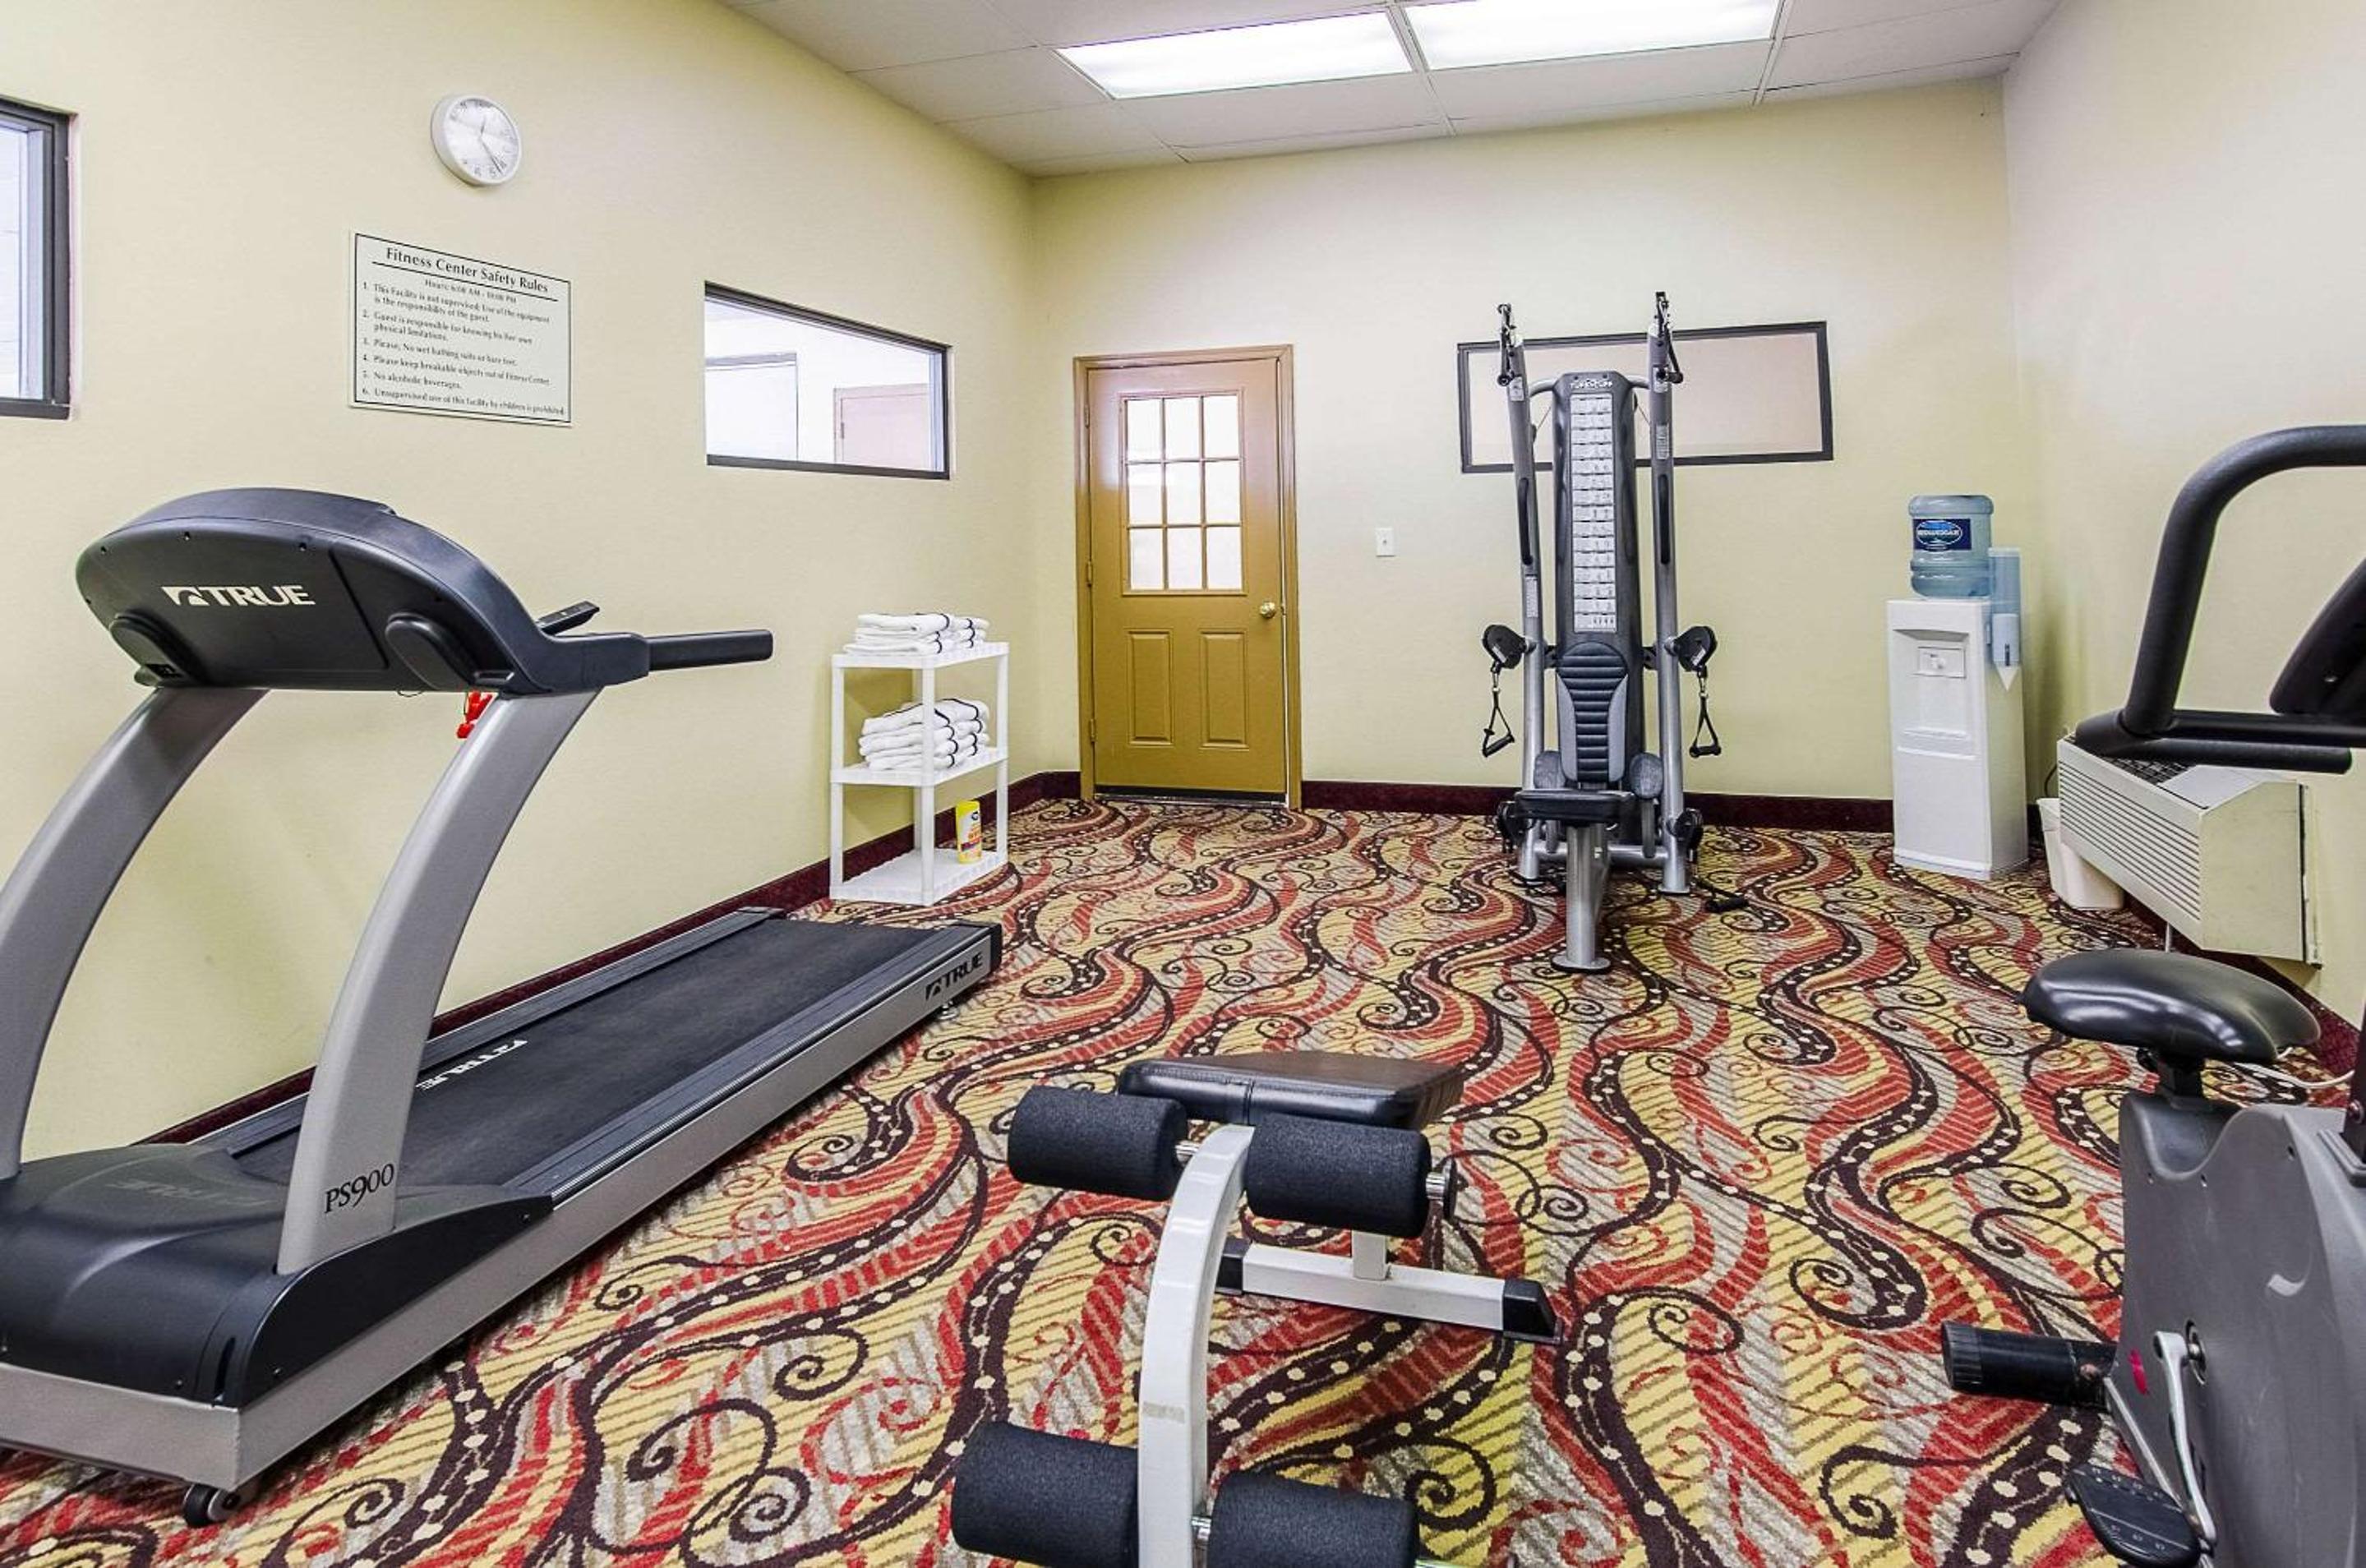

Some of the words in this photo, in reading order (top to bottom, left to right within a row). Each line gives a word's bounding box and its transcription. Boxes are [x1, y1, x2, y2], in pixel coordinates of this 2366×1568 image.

[386, 247, 431, 267] Fitness
[436, 258, 477, 277] Center
[481, 267, 515, 288] Safety
[519, 276, 547, 292] Rules
[374, 283, 389, 293] This
[382, 297, 394, 305] the
[397, 300, 445, 314] responsibility
[456, 310, 468, 318] the
[373, 311, 397, 322] Guest
[406, 318, 449, 330] responsible
[374, 322, 405, 334] physical
[403, 343, 414, 351] No
[431, 346, 459, 359] bathing
[373, 355, 398, 365] Please
[400, 357, 418, 369] keep
[420, 360, 456, 372] breakable
[373, 371, 385, 380] No
[388, 372, 420, 384] alcoholic
[374, 387, 427, 401] Unsupervised
[452, 395, 464, 404] this
[466, 397, 488, 408] facility
[197, 585, 316, 606] TRUE
[940, 951, 983, 989] TRUE
[324, 1163, 394, 1214] PS900
